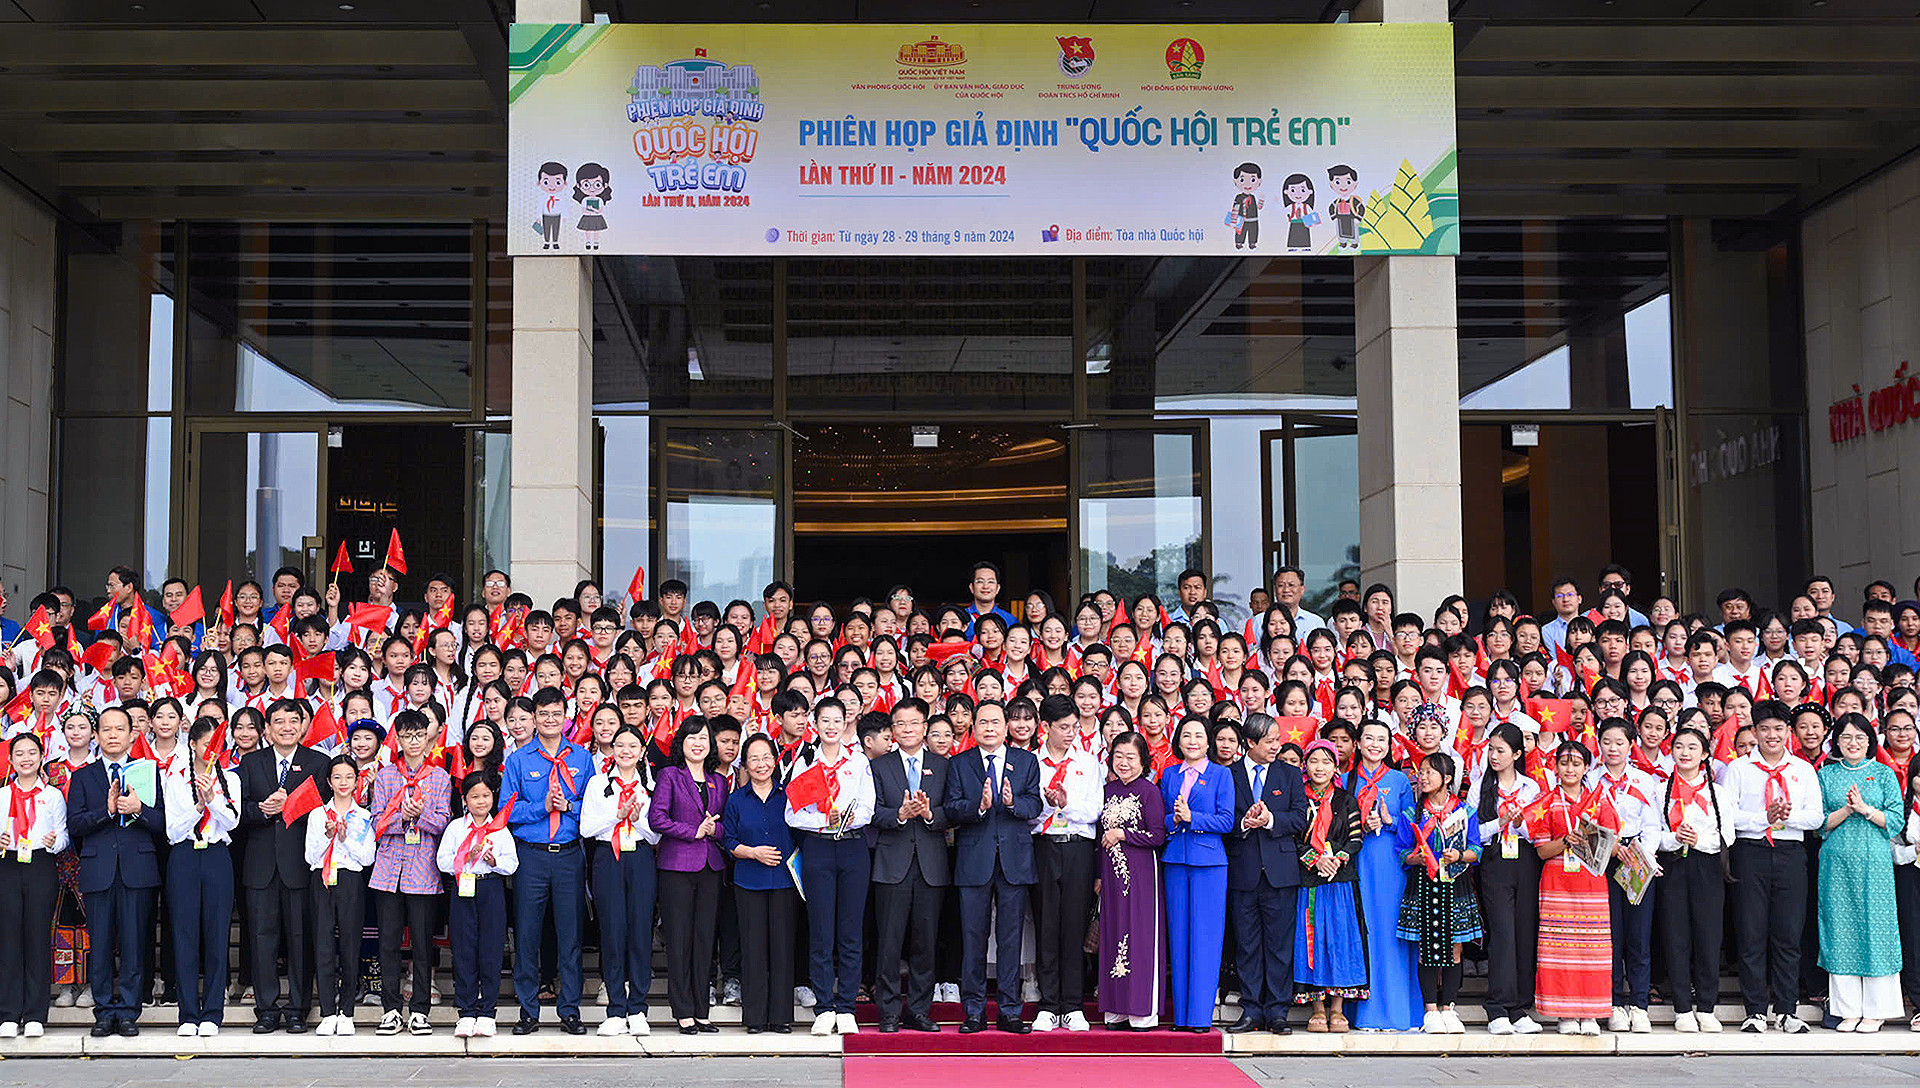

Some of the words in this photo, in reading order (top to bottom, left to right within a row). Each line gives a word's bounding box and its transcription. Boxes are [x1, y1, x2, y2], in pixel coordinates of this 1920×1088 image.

[912, 83, 925, 91] HỘI
[991, 91, 1003, 99] HỘI
[627, 97, 671, 122] PHIÊN
[634, 116, 705, 165] QUỐC
[710, 121, 757, 165] HỘI
[799, 114, 876, 146] PHIÊN
[885, 119, 936, 152] HỌP
[945, 111, 988, 146] GIẢ
[995, 119, 1058, 152] ĐỊNH
[1065, 105, 1162, 152] "QUỐC
[1170, 110, 1217, 152] HỘI
[1226, 108, 1280, 146] TRẺ
[647, 157, 698, 192] TRẺ
[799, 158, 832, 185] LẦN
[838, 162, 877, 185] THỨ
[881, 166, 893, 185] II
[912, 162, 953, 185] NĂM
[959, 165, 1006, 185] 2024
[642, 192, 661, 207] LẦN
[663, 194, 684, 207] THỨ
[698, 194, 721, 207] NĂM
[723, 195, 750, 207] 2024
[787, 230, 807, 242] Thời
[811, 230, 836, 245] gian:
[839, 229, 851, 242] Từ
[854, 230, 879, 245] ngày
[882, 230, 896, 242] 28
[905, 230, 918, 242] 29
[921, 230, 950, 245] tháng
[954, 230, 961, 242] 9
[964, 230, 986, 242] năm
[989, 230, 1015, 242] 2024
[1066, 228, 1082, 244] Địa
[1086, 226, 1113, 242] điểm:
[1116, 228, 1135, 242] Tòa
[1138, 228, 1156, 242] nhà
[1160, 226, 1185, 242] Quốc
[1188, 228, 1205, 243] hội
[1829, 383, 1867, 445] NHÀ
